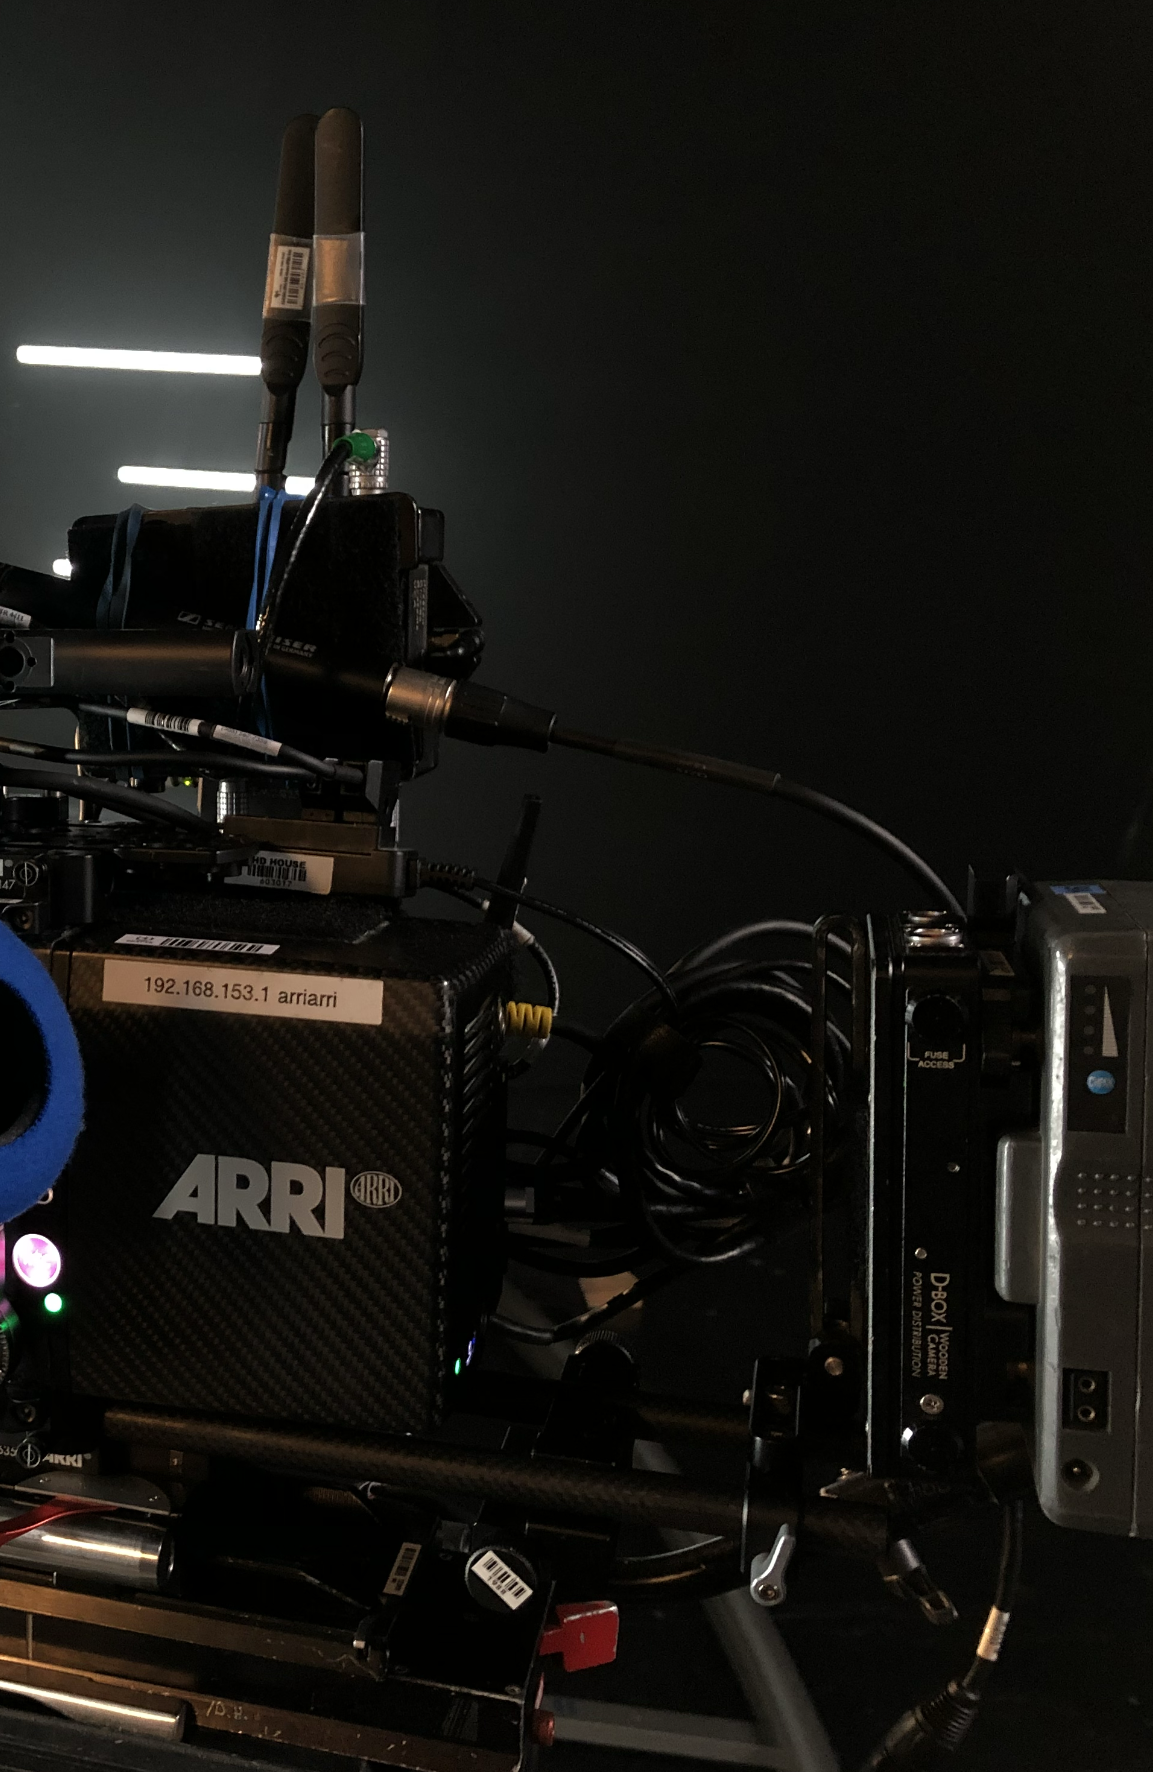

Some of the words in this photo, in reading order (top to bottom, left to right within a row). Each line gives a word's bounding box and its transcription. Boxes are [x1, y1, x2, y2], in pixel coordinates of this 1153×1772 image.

[252, 856, 267, 865] HD
[270, 858, 307, 869] HOUSE
[144, 976, 269, 1002] 192.168.153.1
[278, 989, 337, 1008] arriarri
[917, 1060, 955, 1069] ACCESS
[924, 1050, 949, 1060] FUSE
[152, 1153, 345, 1240] ARRI
[353, 1173, 397, 1206] ARRI
[912, 1270, 923, 1307] POWER
[930, 1272, 950, 1323] D-BOX
[911, 1310, 923, 1379] DISTRIBUTION
[927, 1333, 939, 1377] CAMERA
[938, 1331, 950, 1380] WOODEN
[42, 1452, 83, 1468] ARRI
